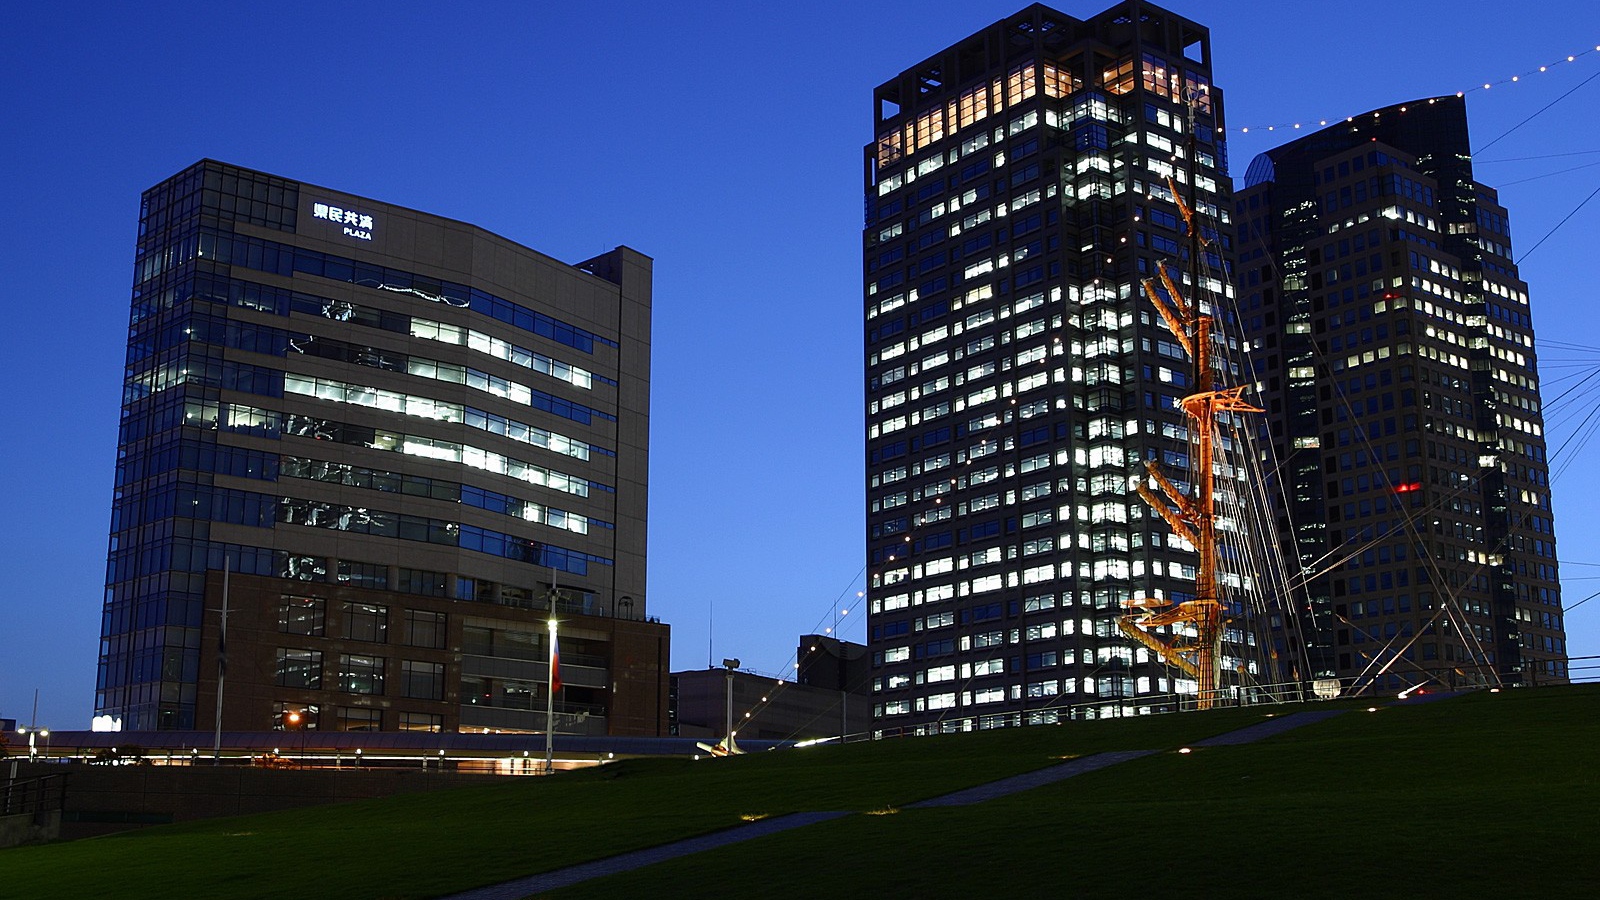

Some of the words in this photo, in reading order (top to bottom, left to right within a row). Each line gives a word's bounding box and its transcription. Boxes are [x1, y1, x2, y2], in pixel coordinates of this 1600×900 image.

[313, 202, 373, 230] 県民共済
[343, 227, 372, 241] PLAZA
